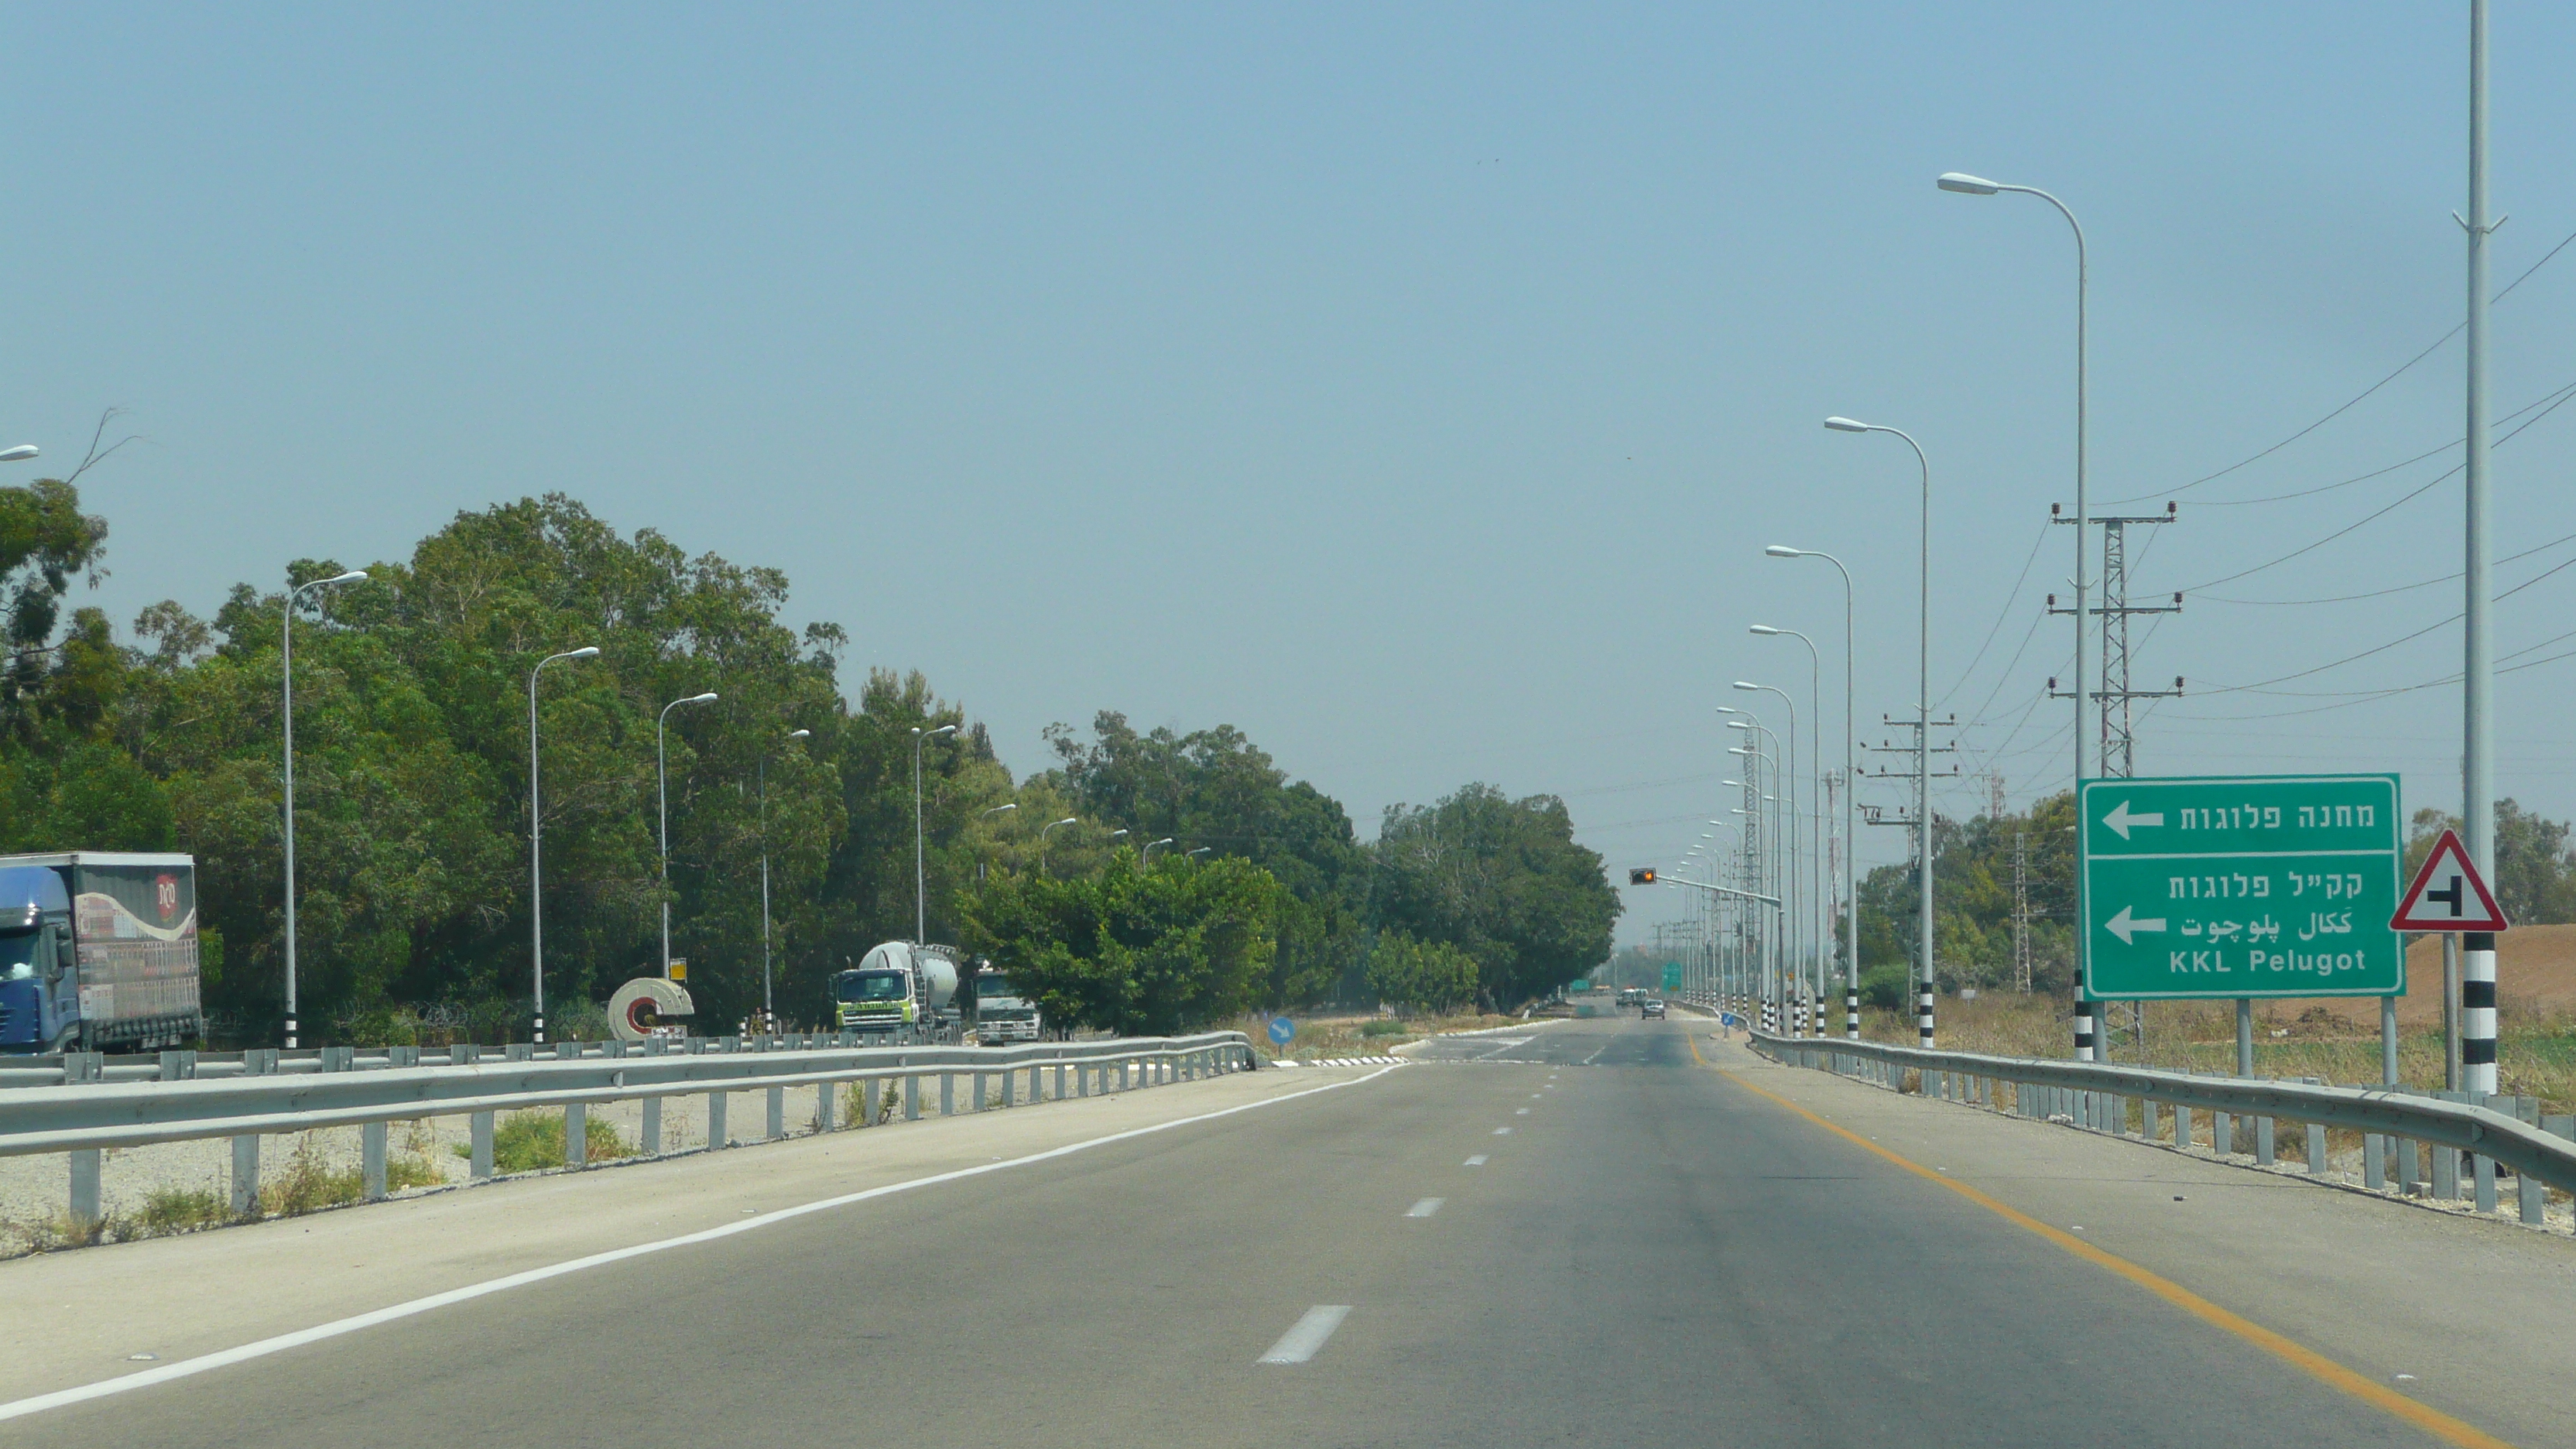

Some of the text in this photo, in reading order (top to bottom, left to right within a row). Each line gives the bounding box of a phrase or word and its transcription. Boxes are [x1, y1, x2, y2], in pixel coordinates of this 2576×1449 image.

[2180, 803, 2374, 829] מחנה פלוגות
[2170, 872, 2269, 899] פלוגות
[2170, 949, 2365, 976] KKL Pelugot
